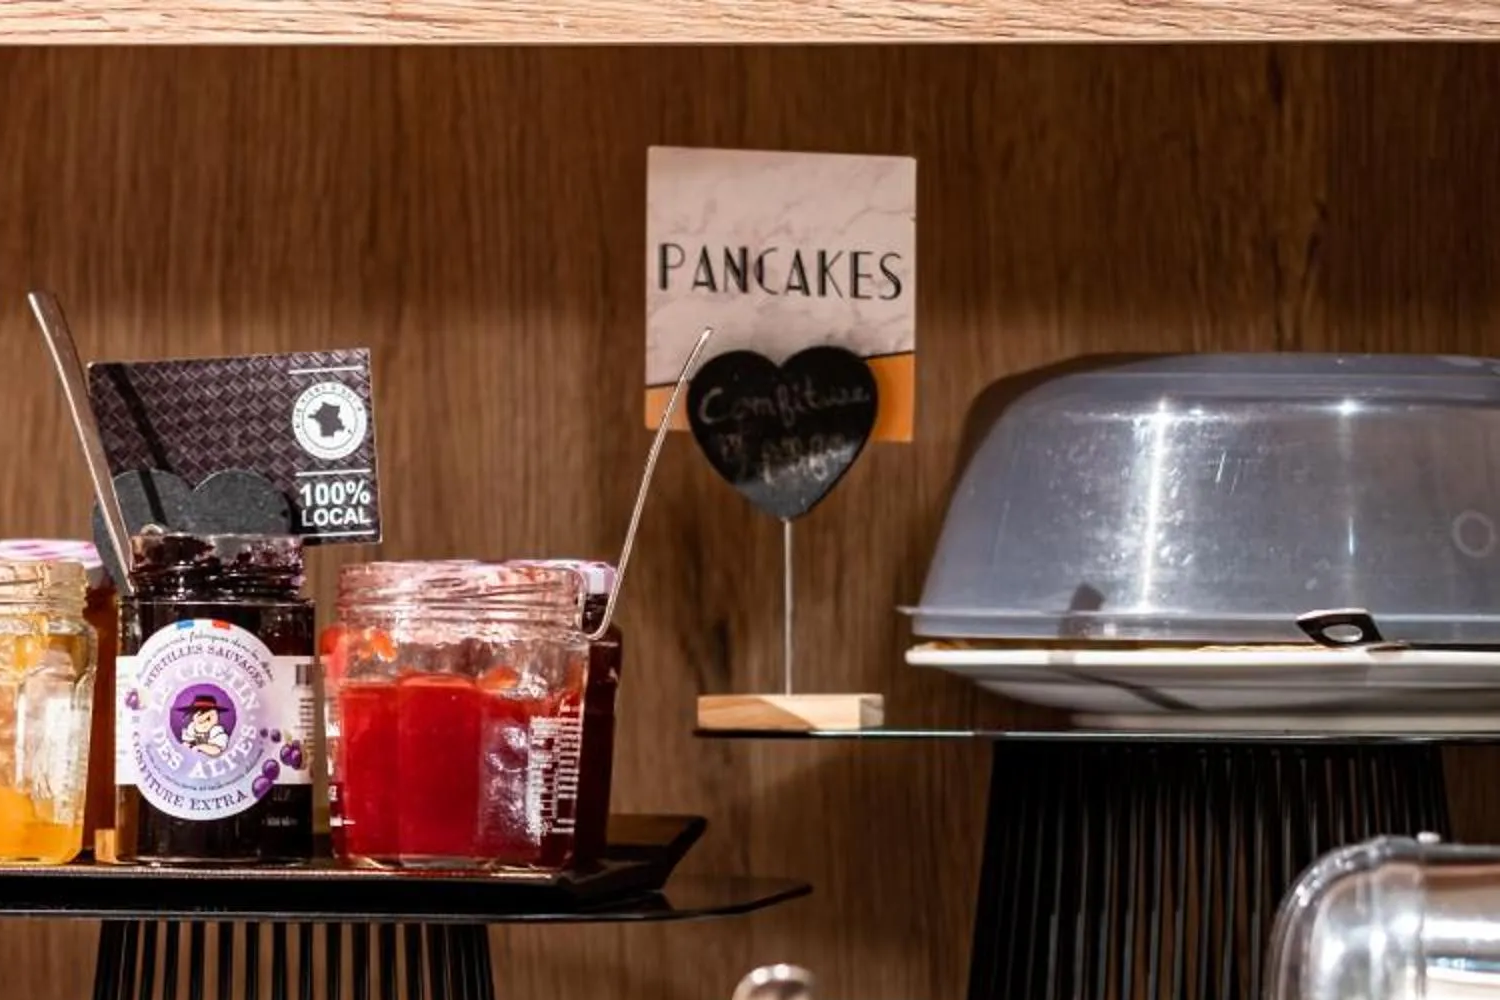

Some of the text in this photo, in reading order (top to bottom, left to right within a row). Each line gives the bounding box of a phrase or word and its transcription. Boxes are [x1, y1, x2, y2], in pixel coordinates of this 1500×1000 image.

[657, 242, 903, 301] PANCAKES
[300, 480, 371, 507] 100%
[302, 506, 371, 528] LOCAL
[144, 645, 266, 689] MYRTILLES SAUVAGES
[190, 789, 249, 811] EXTRA
